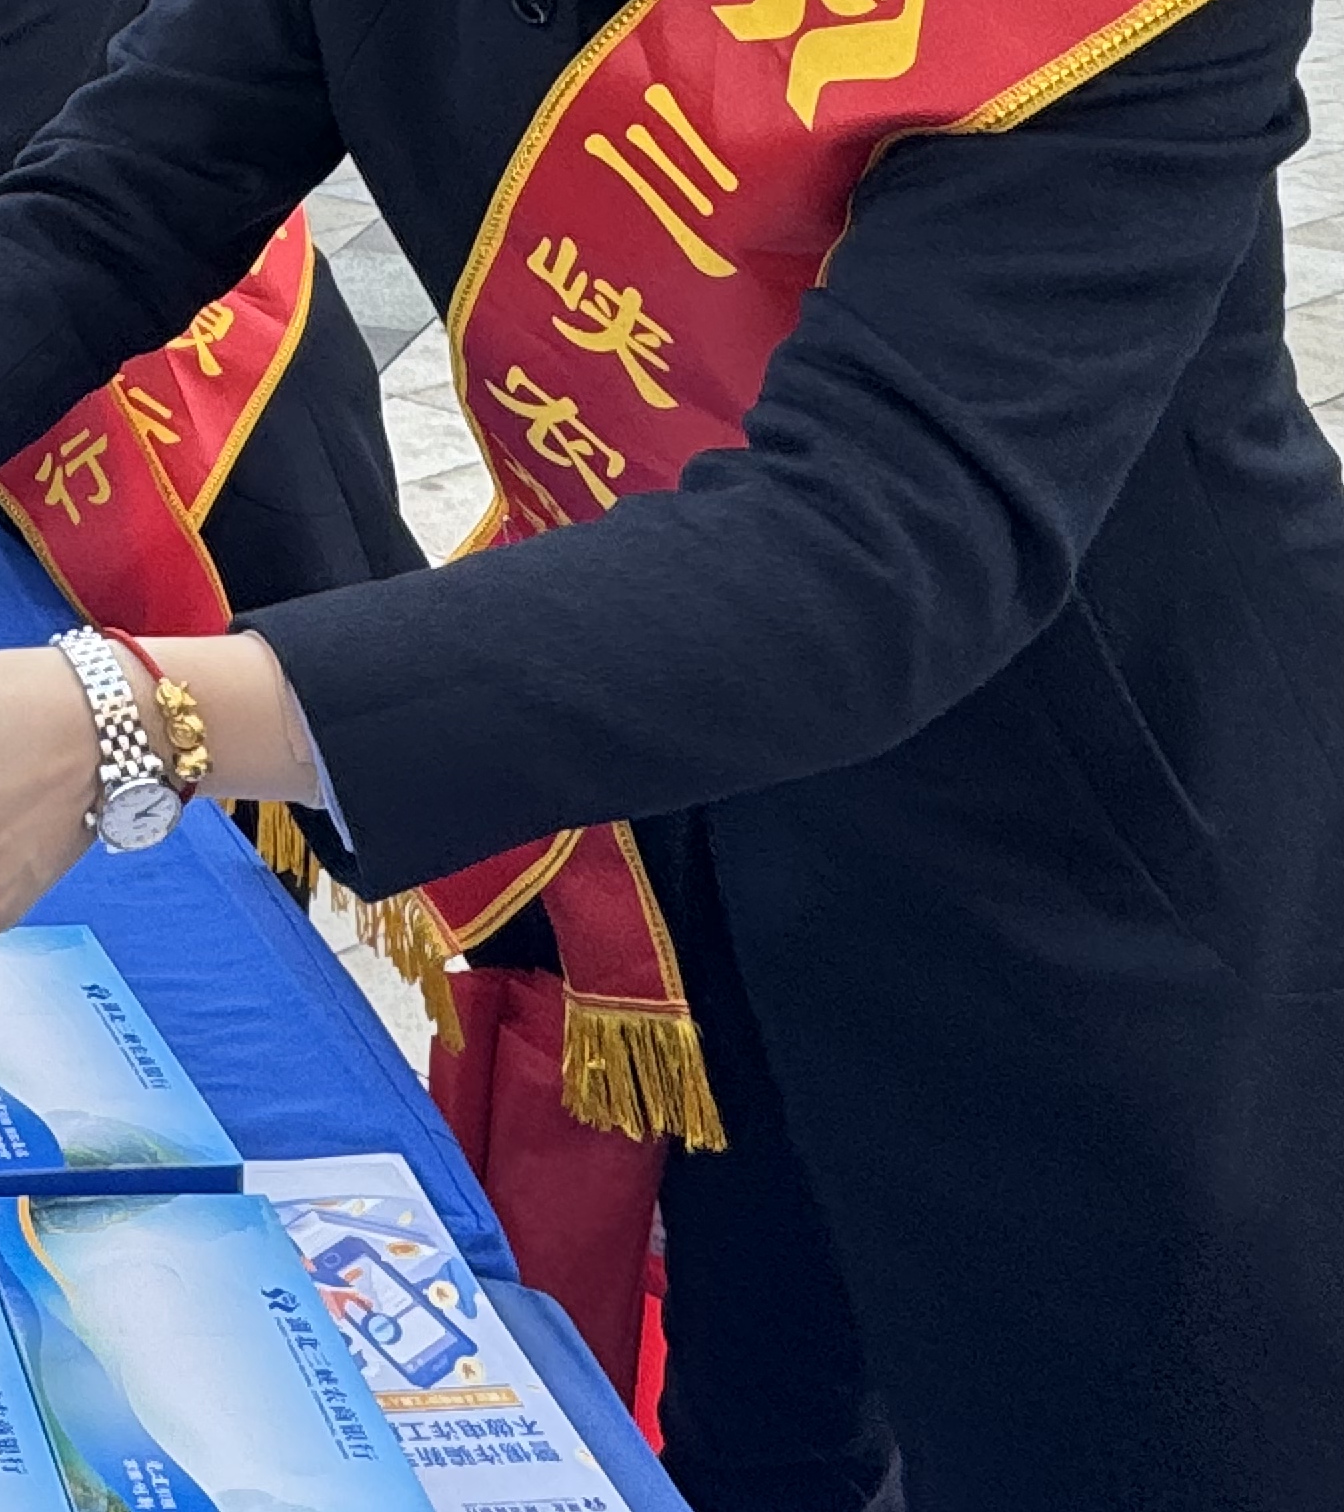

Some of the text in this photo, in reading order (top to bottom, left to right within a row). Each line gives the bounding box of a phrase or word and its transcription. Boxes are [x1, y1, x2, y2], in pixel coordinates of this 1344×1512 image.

[484, 81, 740, 528] 三峡农
[34, 428, 113, 526] 行
